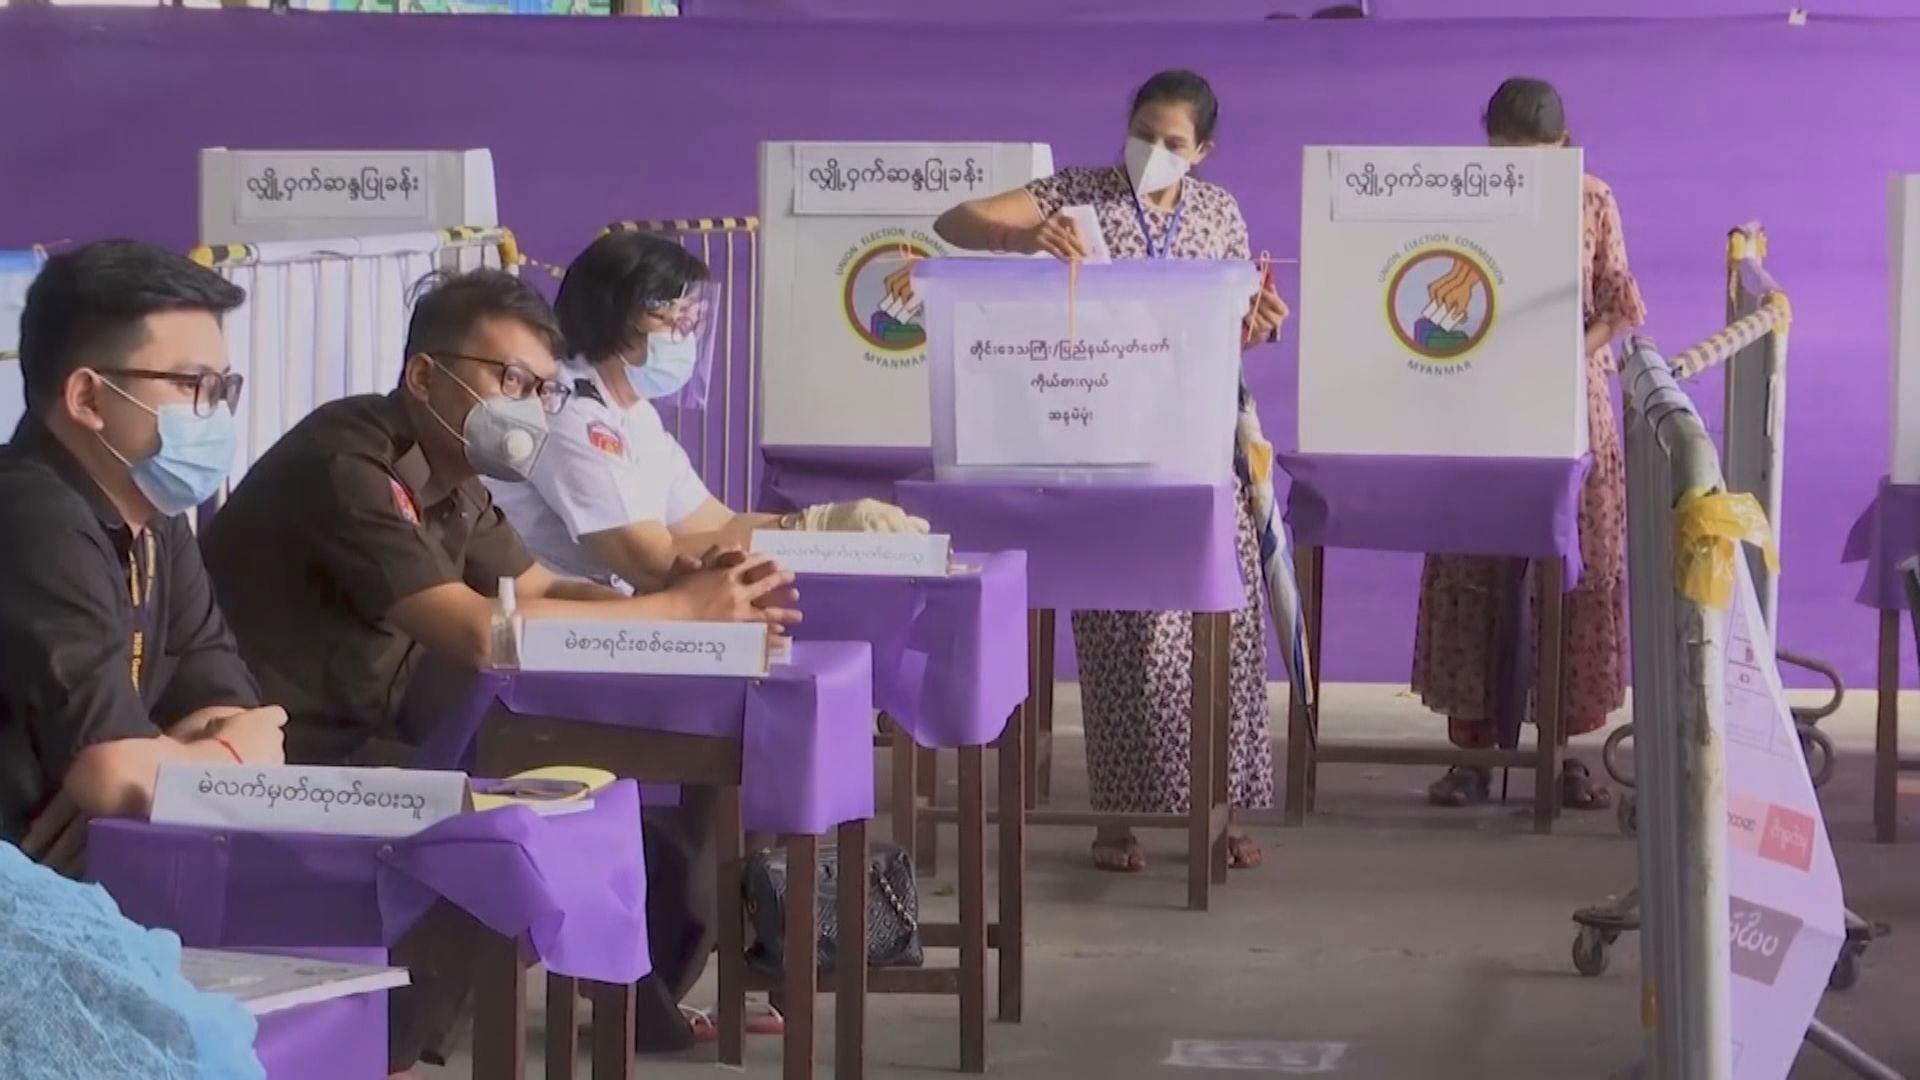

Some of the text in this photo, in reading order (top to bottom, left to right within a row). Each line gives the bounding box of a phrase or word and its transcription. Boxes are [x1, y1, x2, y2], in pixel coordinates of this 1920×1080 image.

[835, 245, 858, 276] UNION
[860, 227, 906, 245] ELECTION
[1378, 233, 1505, 285] UNION ELECTION COMMISSION
[863, 352, 927, 369] MYANMAR
[1407, 359, 1472, 376] MYANMAR
[565, 629, 726, 662] မဲစာရင်းစစ်ဆေးသူ
[199, 771, 425, 820] မဲလက်မှတ်ထုတ်ပေးသူ
